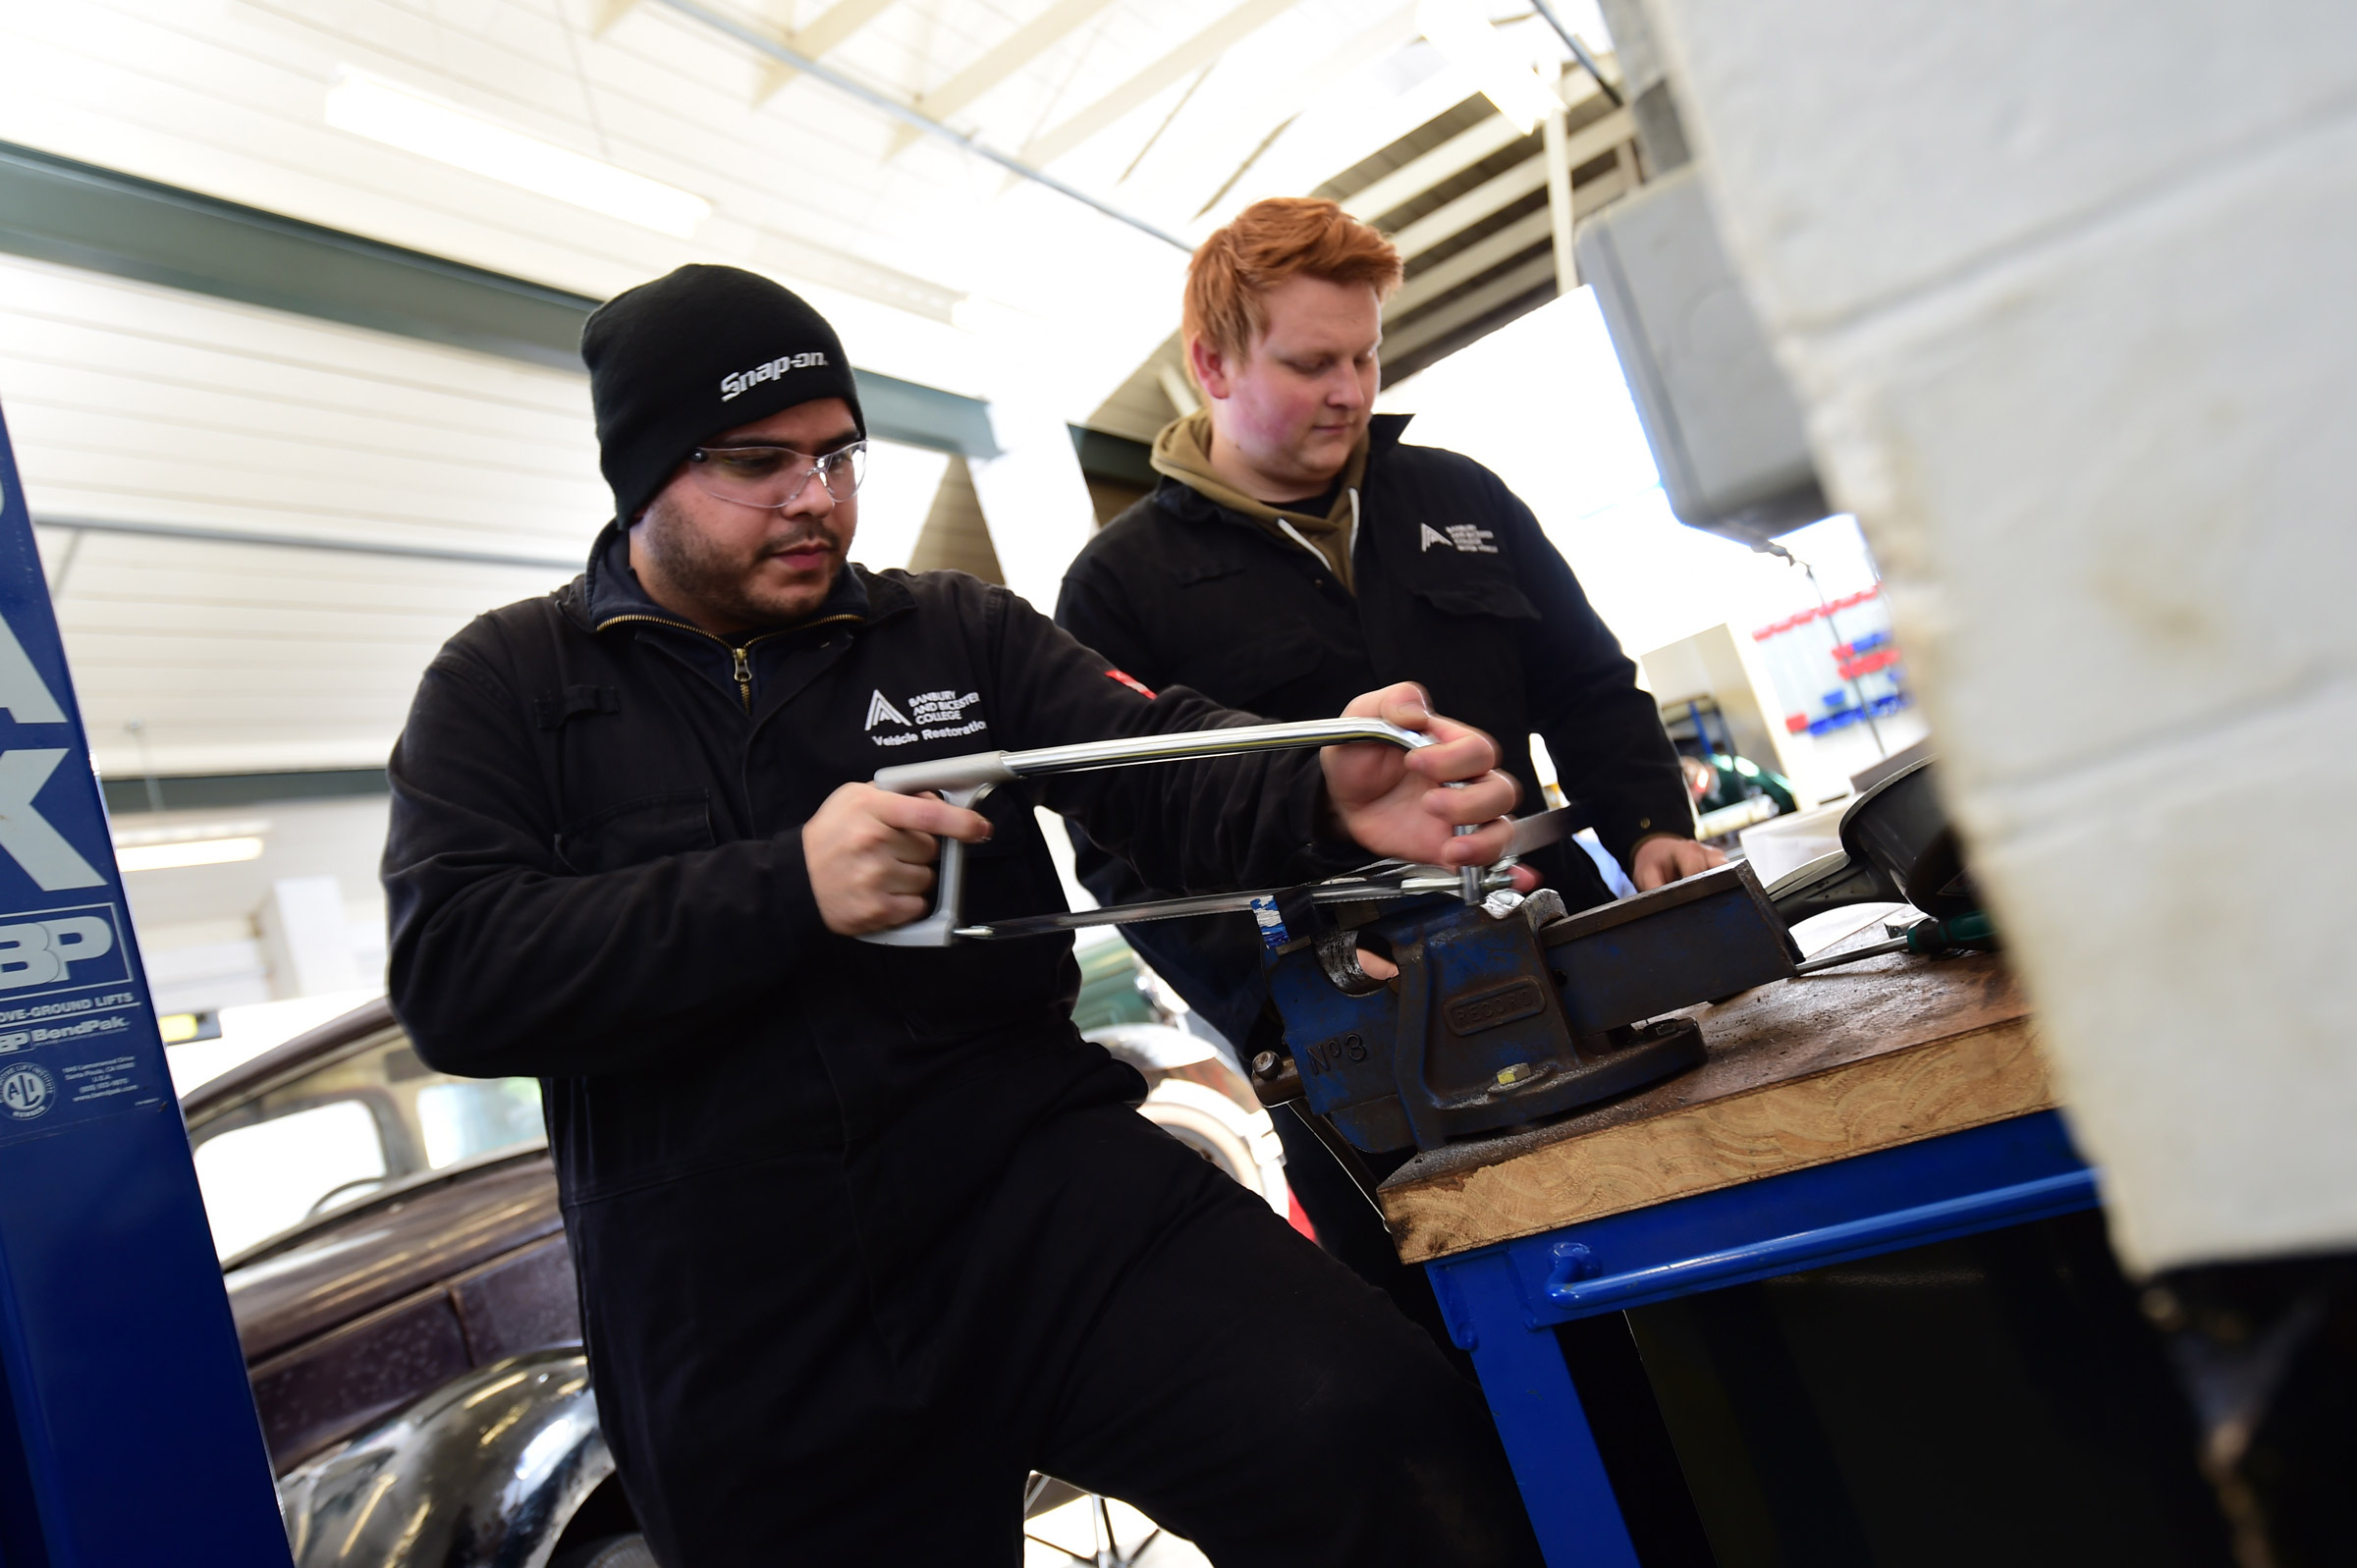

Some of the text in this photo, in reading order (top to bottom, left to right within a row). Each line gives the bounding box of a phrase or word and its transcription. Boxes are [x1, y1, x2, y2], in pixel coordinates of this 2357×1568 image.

[720, 351, 825, 403] Snap-on
[908, 690, 957, 708] BANBURY
[913, 702, 938, 717] AND
[914, 711, 962, 726] COLLEGE
[871, 720, 988, 746] Vehicle Restoratio
[94, 992, 136, 1007] LIFTS
[1455, 988, 1534, 1029] RECORD
[30, 1016, 127, 1042] BendPak
